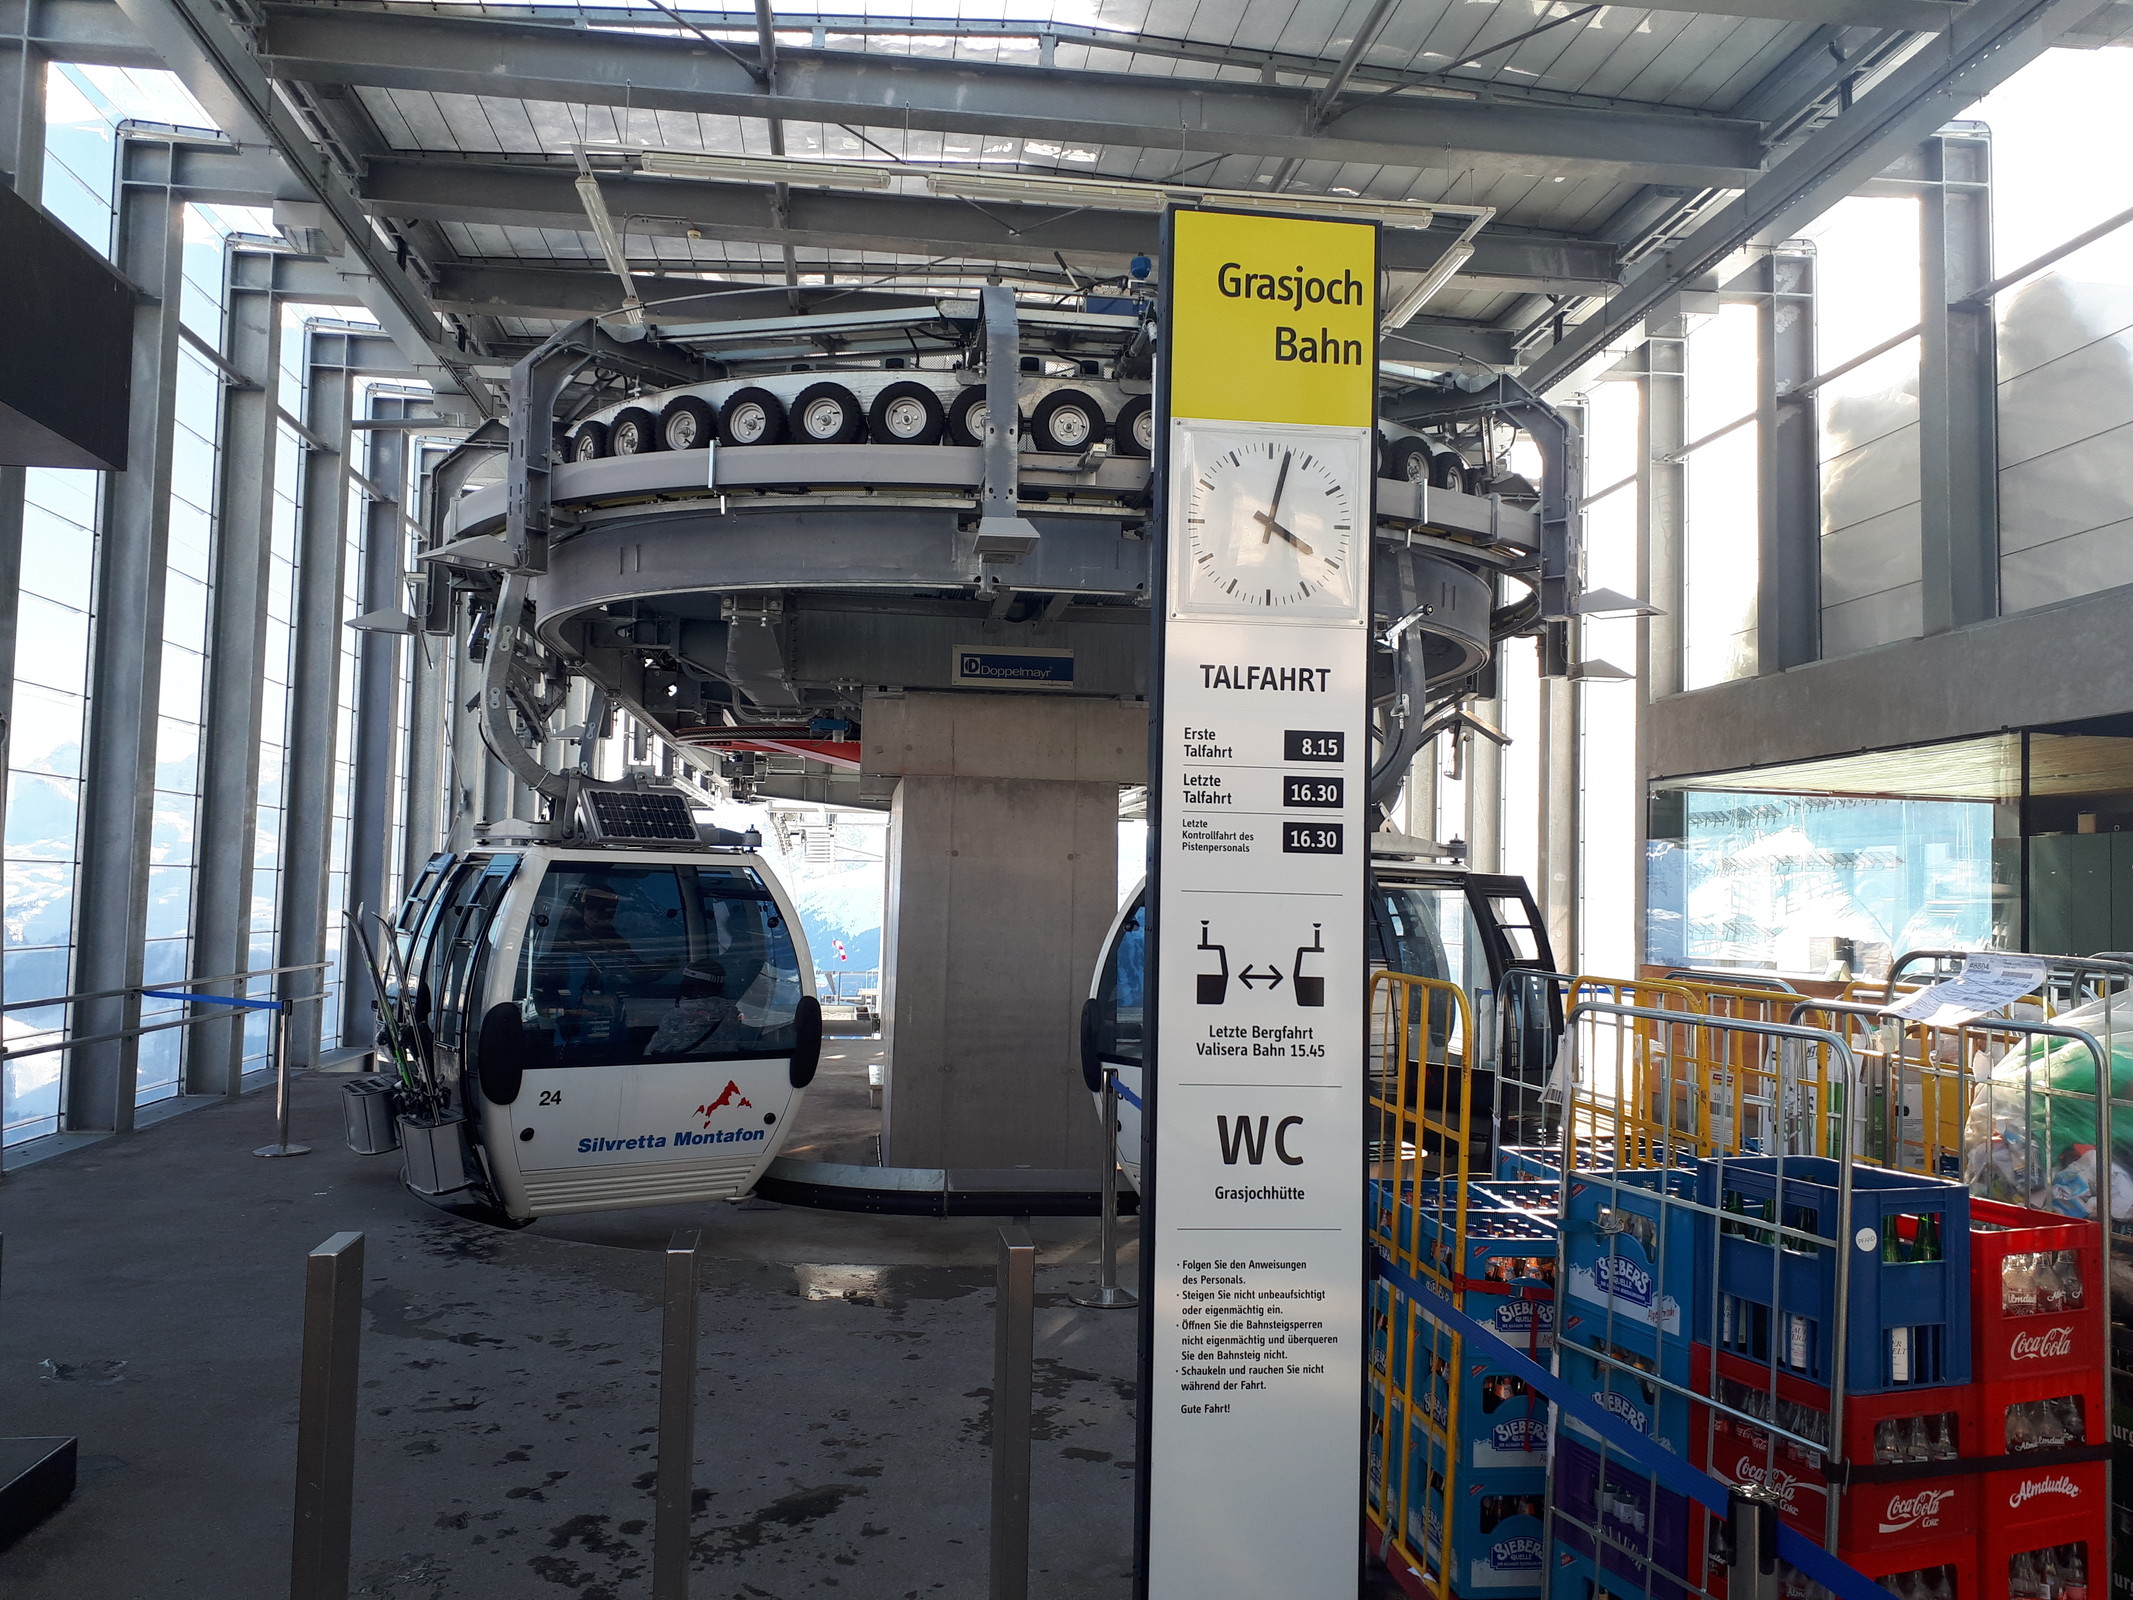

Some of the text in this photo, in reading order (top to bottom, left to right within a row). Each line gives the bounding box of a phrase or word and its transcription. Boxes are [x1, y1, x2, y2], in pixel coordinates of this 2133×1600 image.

[1218, 262, 1363, 312] Grasjoch
[1275, 326, 1362, 366] Bahn
[981, 665, 1051, 679] Doppelmayr
[1200, 664, 1331, 692] TALFAHRT
[1184, 727, 1216, 741] Erste
[1184, 745, 1233, 758] Talfahrt
[1302, 738, 1338, 756] 8.15
[1183, 773, 1221, 787] Letzte
[1183, 791, 1232, 805] Talfahrt
[1291, 784, 1338, 802] 16.30
[1182, 819, 1208, 828] Letzte
[1182, 830, 1254, 841] Kontrollfahrt des
[1290, 830, 1337, 848] 16.30
[1182, 842, 1250, 853] Pistenpersonals
[1209, 1025, 1313, 1042] Letzte Bergfahrt
[1196, 1042, 1325, 1057] Valisera Bahn 15.45
[538, 1090, 562, 1106] 24
[577, 1128, 765, 1153] Silvretta Montafon
[1217, 1115, 1304, 1165] WC
[1215, 1186, 1305, 1203] Grasjochhütte
[1857, 1235, 1876, 1244] PFAND
[1182, 1260, 1306, 1271] Folgen Sie den Anweisungen
[1182, 1275, 1246, 1284] des Personals.
[1182, 1290, 1325, 1301] Steigen Sie nicht unbeaufsichtigt
[1182, 1305, 1283, 1316] oder eigenmächtig ein.
[1182, 1319, 1322, 1331] Öffnen Sie die Bahnsteigsperren
[1182, 1335, 1338, 1347] nicht eigenmächtig und überqueren
[2010, 1326, 2074, 1361] Coca-Cola
[1181, 1350, 1287, 1361] Sie den Bahnsteig nicht.
[1181, 1365, 1324, 1375] Schaukeln und rauchen Sie nicht
[1181, 1380, 1266, 1390] während der Fahrt.
[1181, 1404, 1230, 1414] Gute Fahrt!
[2009, 1475, 2079, 1508] Almdudler
[1780, 1500, 1799, 1516] Coke
[1887, 1490, 1941, 1520] Coca-Cola
[1922, 1517, 1939, 1528] Coke
